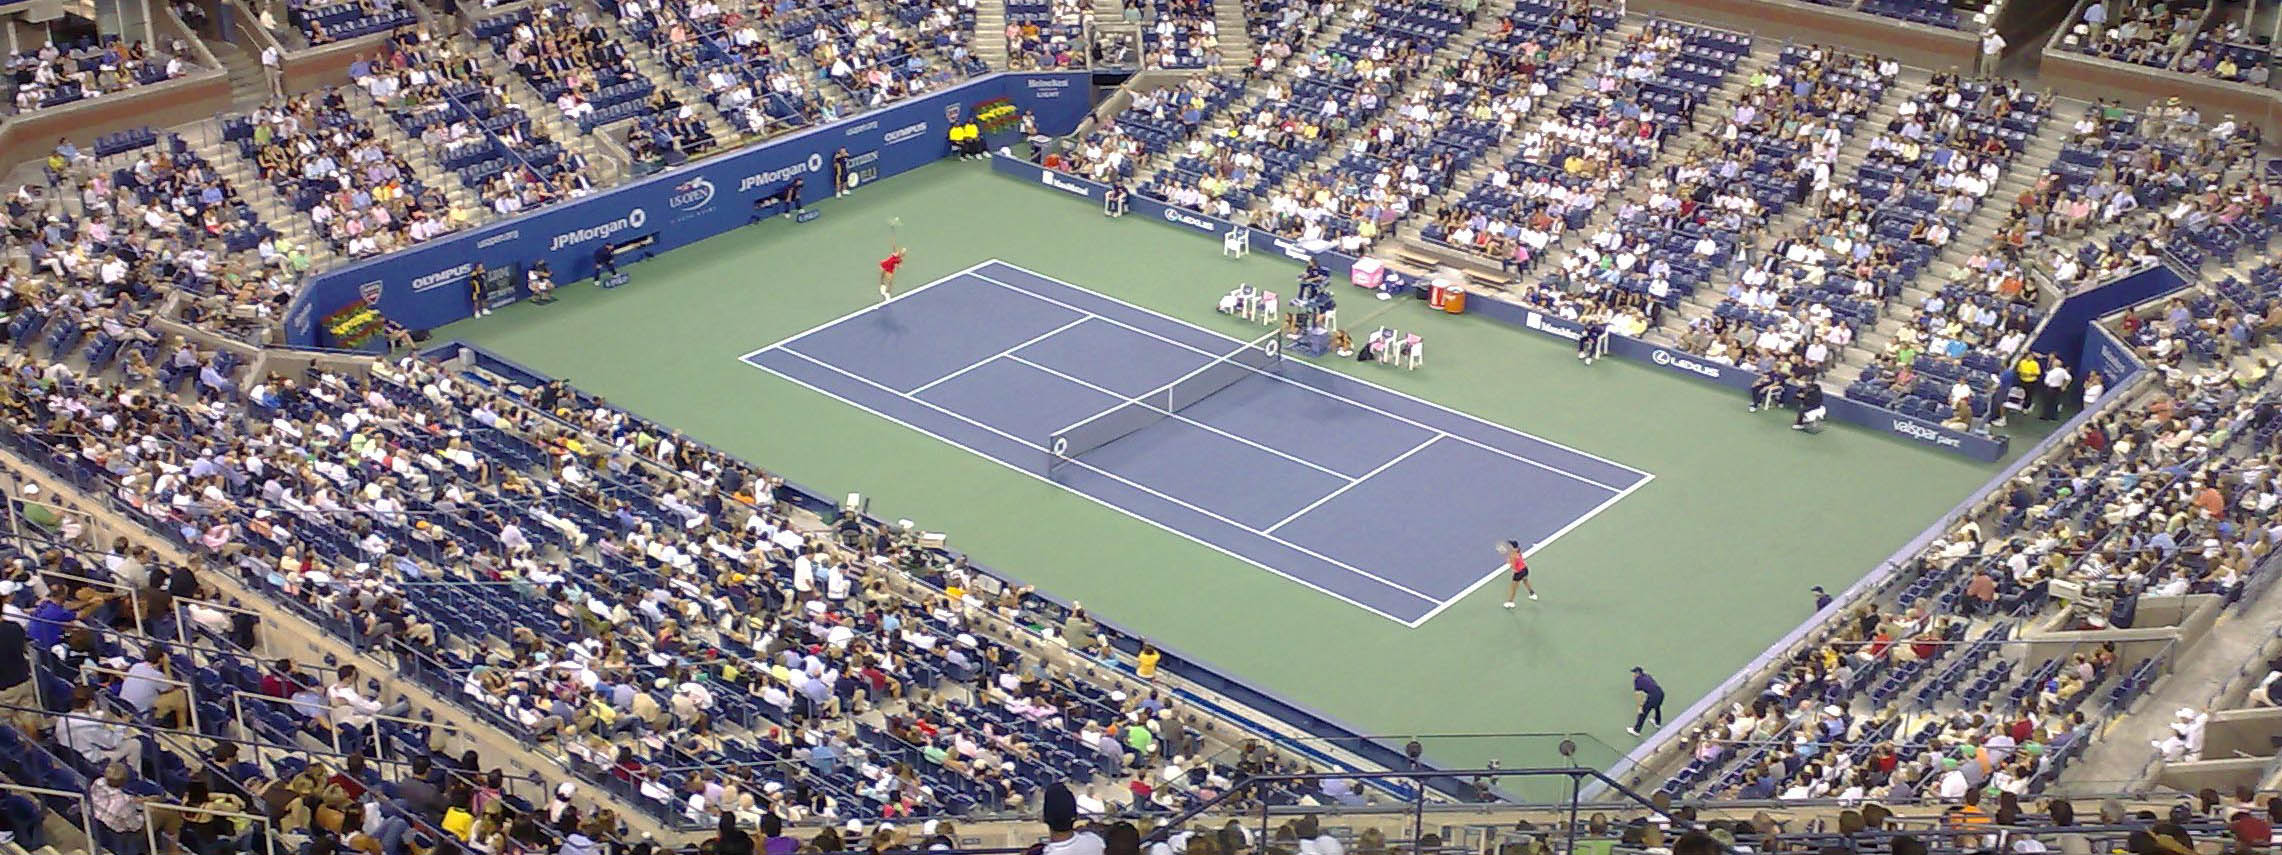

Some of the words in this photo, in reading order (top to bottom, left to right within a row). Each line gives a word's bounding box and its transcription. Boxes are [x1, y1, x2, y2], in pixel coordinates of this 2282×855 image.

[884, 121, 927, 142] OLYMPUS
[738, 162, 807, 192] JPMorgan
[550, 218, 628, 251] JPMorgan
[1177, 214, 1215, 232] LEXUS
[412, 263, 473, 290] OLYMPUS
[1670, 356, 1720, 379] LEXUS
[1893, 419, 1938, 440] valspar
